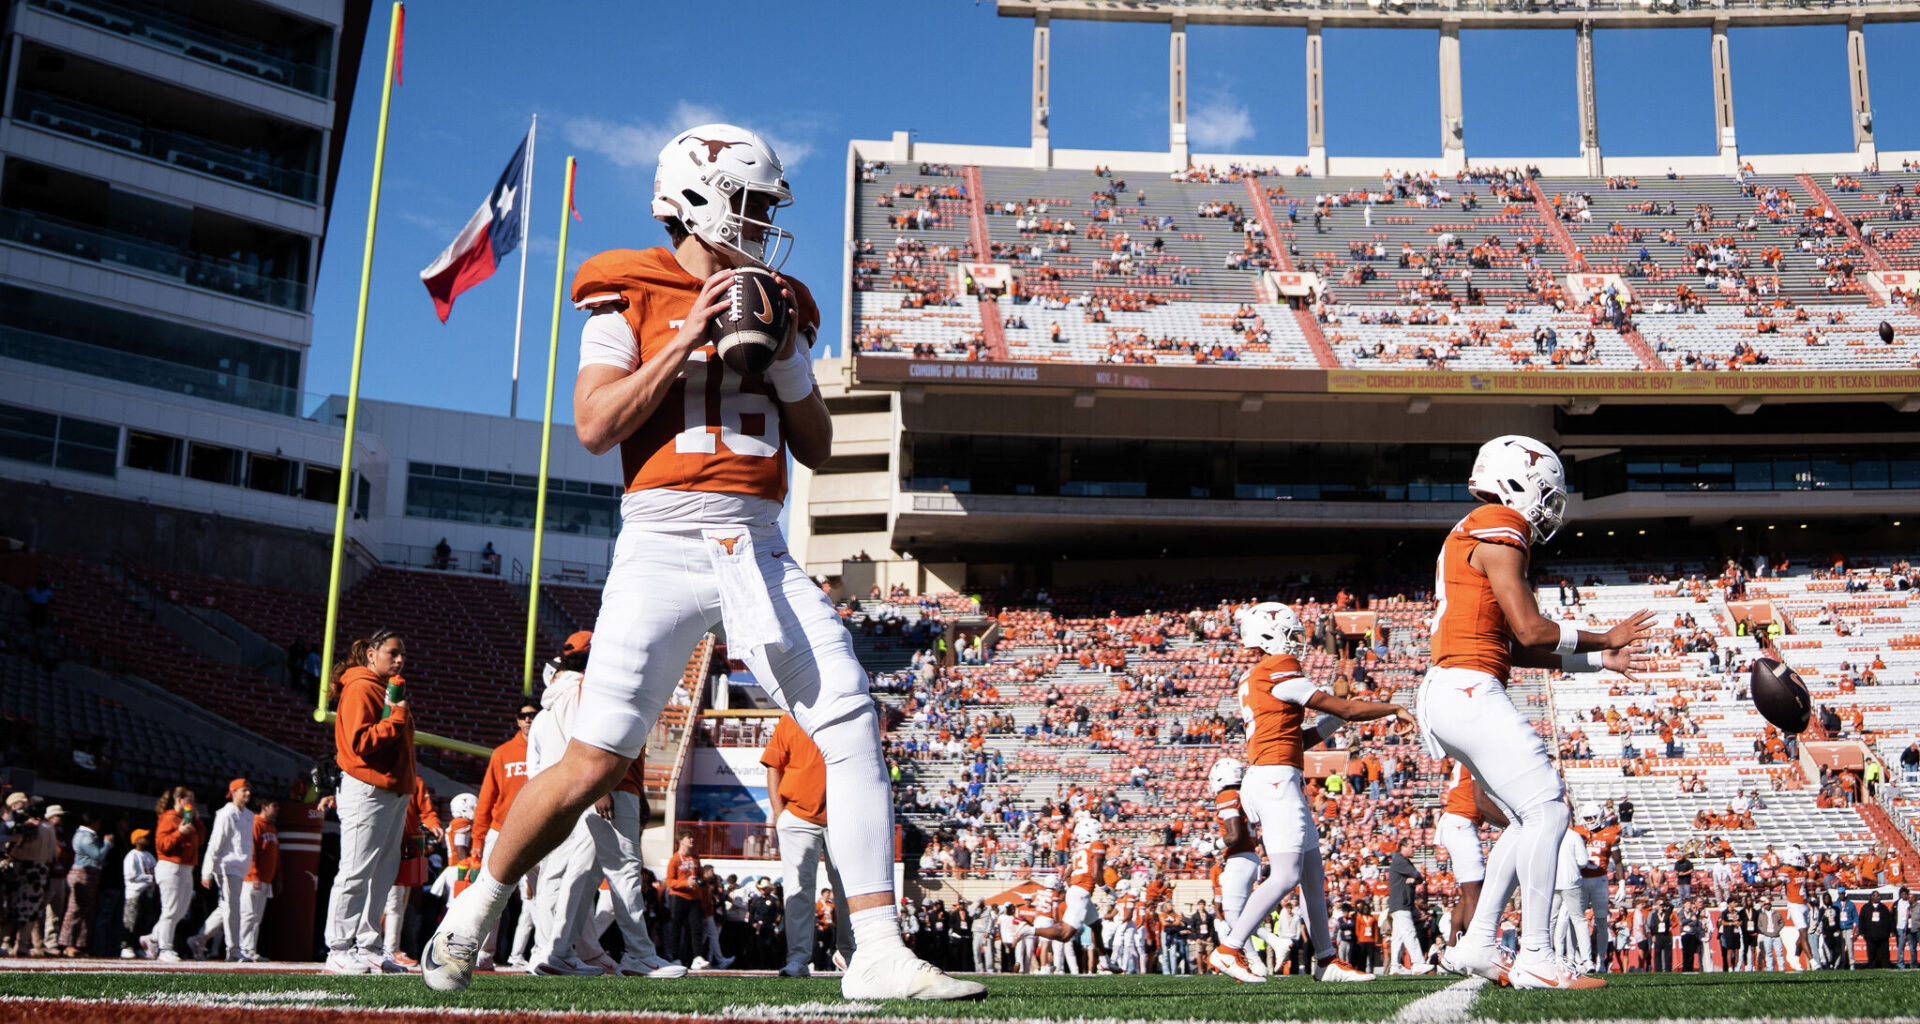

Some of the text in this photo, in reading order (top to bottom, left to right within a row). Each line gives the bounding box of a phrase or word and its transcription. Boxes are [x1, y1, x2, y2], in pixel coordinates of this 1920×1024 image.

[909, 364, 1038, 380] COMING UP ON THE FORTY ACRES
[1366, 374, 1415, 388] CONECUH
[1417, 375, 1465, 388] SAUSAGE
[1493, 376, 1518, 389] TRUE
[1521, 376, 1575, 389] SOUTHERN
[1577, 376, 1615, 390] FLAVOR
[1618, 376, 1648, 390] SINCE
[1650, 376, 1673, 390] 1947
[1715, 376, 1750, 390] PROUD
[1752, 376, 1801, 389] SPONSOR
[1803, 376, 1816, 389] OF
[1818, 375, 1838, 388] THE
[1839, 375, 1871, 388] TEXAS
[674, 350, 780, 458] 16
[504, 761, 527, 778] TE
[716, 764, 767, 776] AAdvanta
